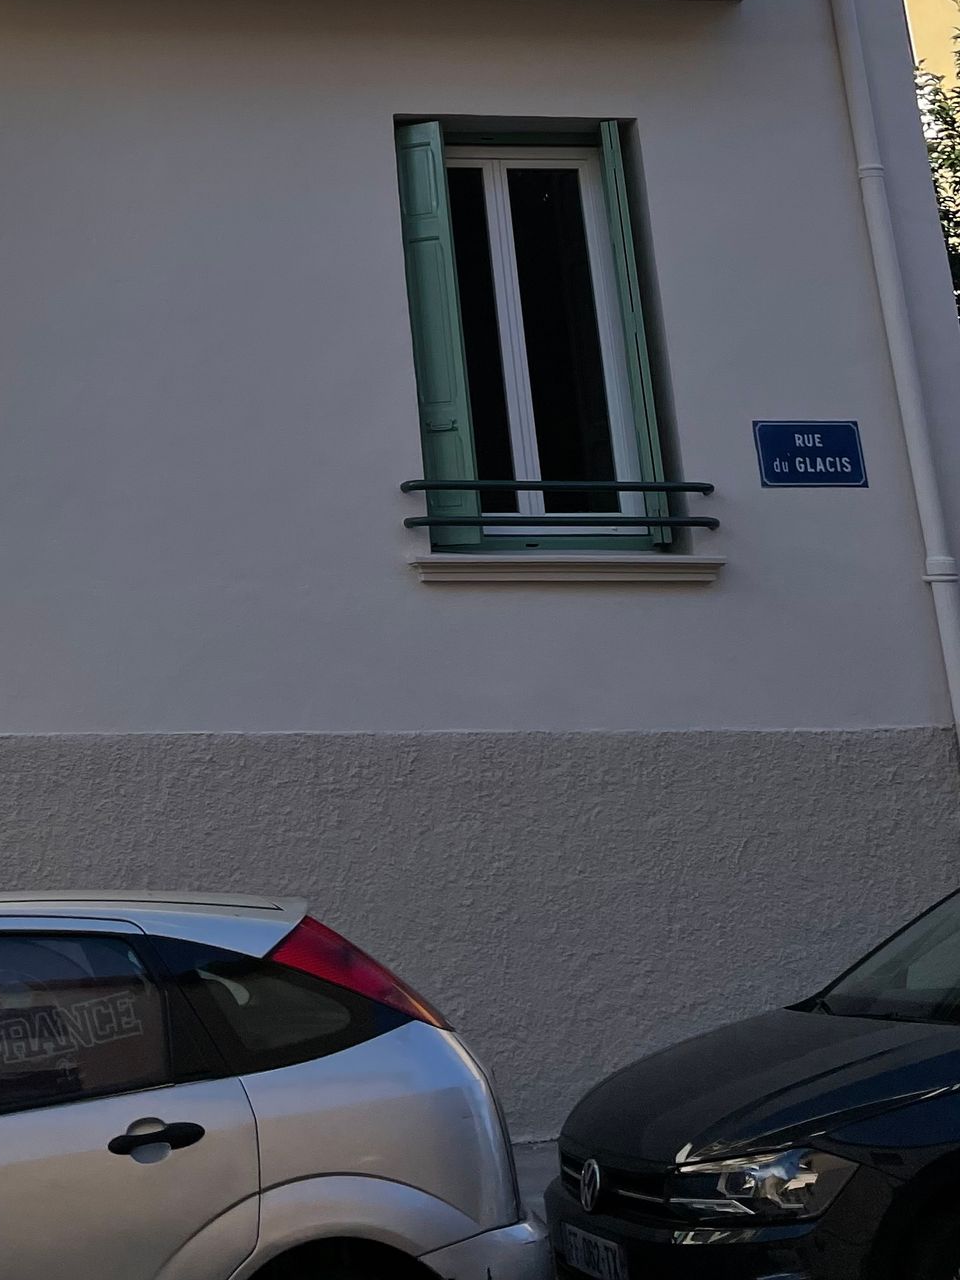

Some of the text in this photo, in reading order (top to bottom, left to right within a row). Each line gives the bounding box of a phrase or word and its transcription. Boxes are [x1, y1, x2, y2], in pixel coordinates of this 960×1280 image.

[794, 433, 823, 447] RUE
[773, 456, 852, 472] du GLACIS
